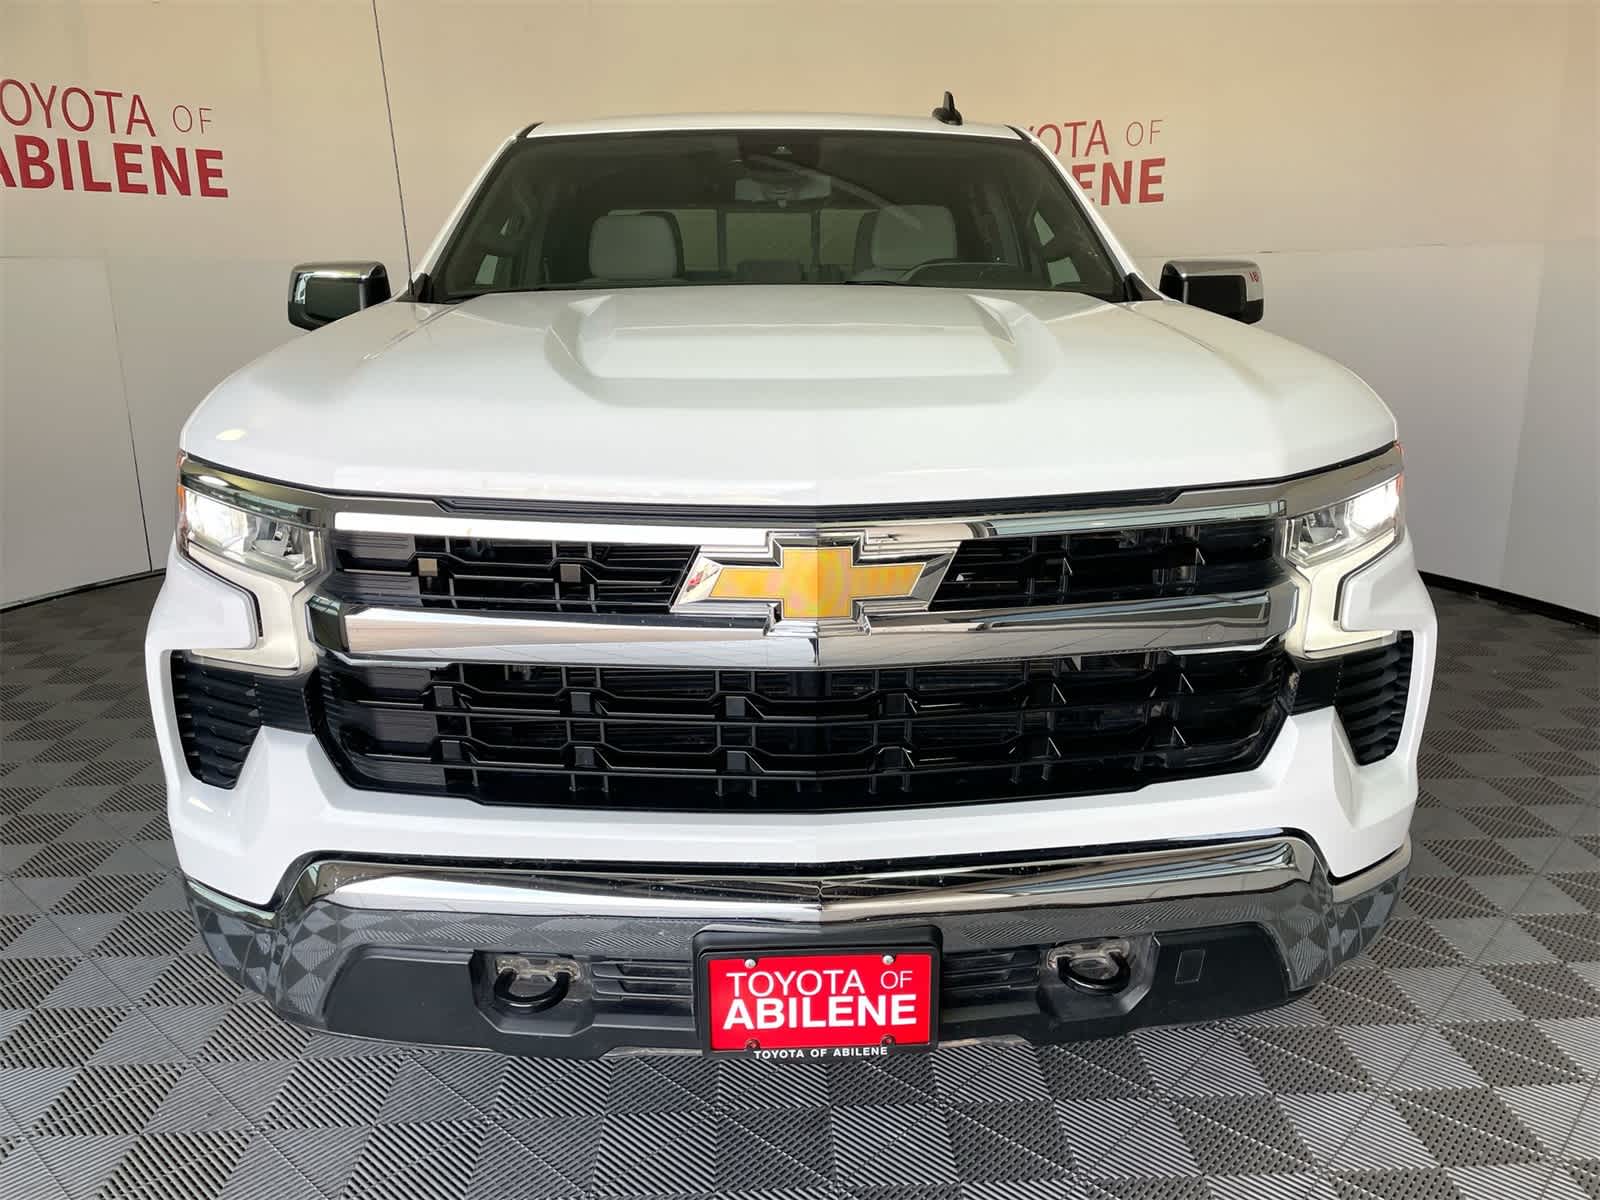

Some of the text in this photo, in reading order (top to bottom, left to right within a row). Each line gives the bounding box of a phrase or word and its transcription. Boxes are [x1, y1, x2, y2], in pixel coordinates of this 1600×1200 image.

[172, 104, 212, 134] OF
[1029, 119, 1163, 158] OTA OF
[726, 969, 913, 998] TOYOTA OF
[723, 994, 917, 1030] ABILENE
[753, 1046, 888, 1060] TOYOTA OF ABILENE
